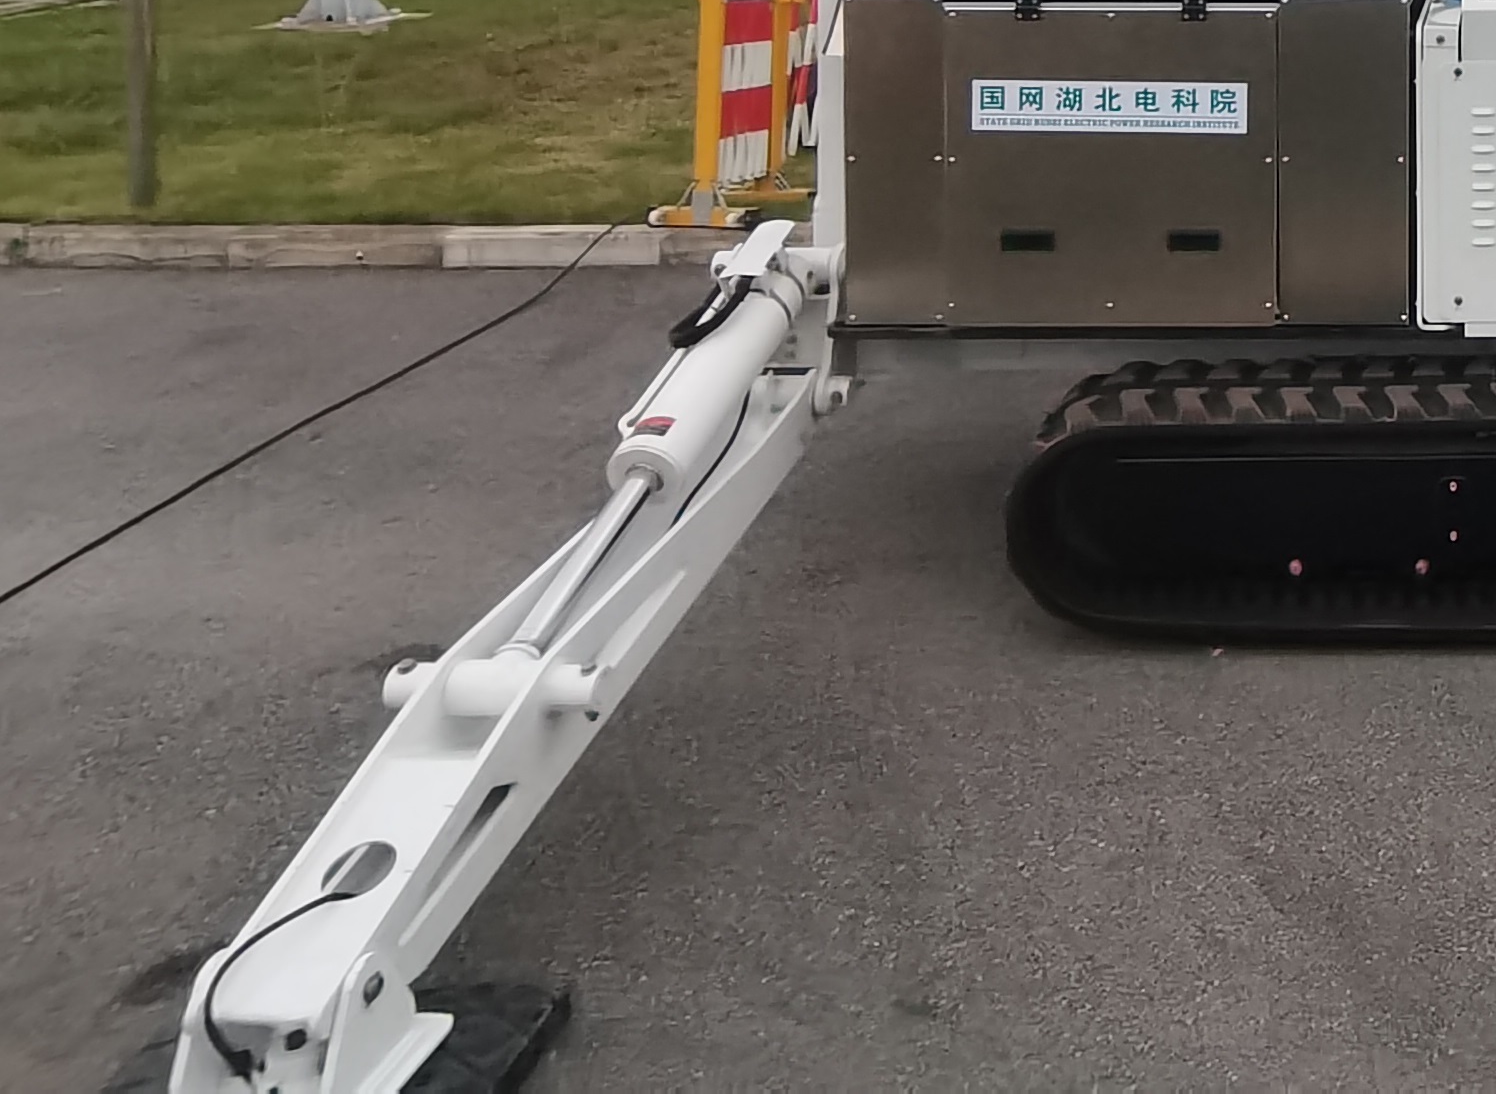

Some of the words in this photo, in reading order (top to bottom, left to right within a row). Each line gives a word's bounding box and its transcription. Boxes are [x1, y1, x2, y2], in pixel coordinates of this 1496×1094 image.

[979, 85, 1238, 115] 国网湖北电科院
[979, 117, 1008, 126] STATE
[1063, 118, 1108, 127] ELECTRIC
[1109, 119, 1141, 128] POWER
[1142, 120, 1191, 128] RESEARCH
[1192, 120, 1240, 129] INSTITUTE
